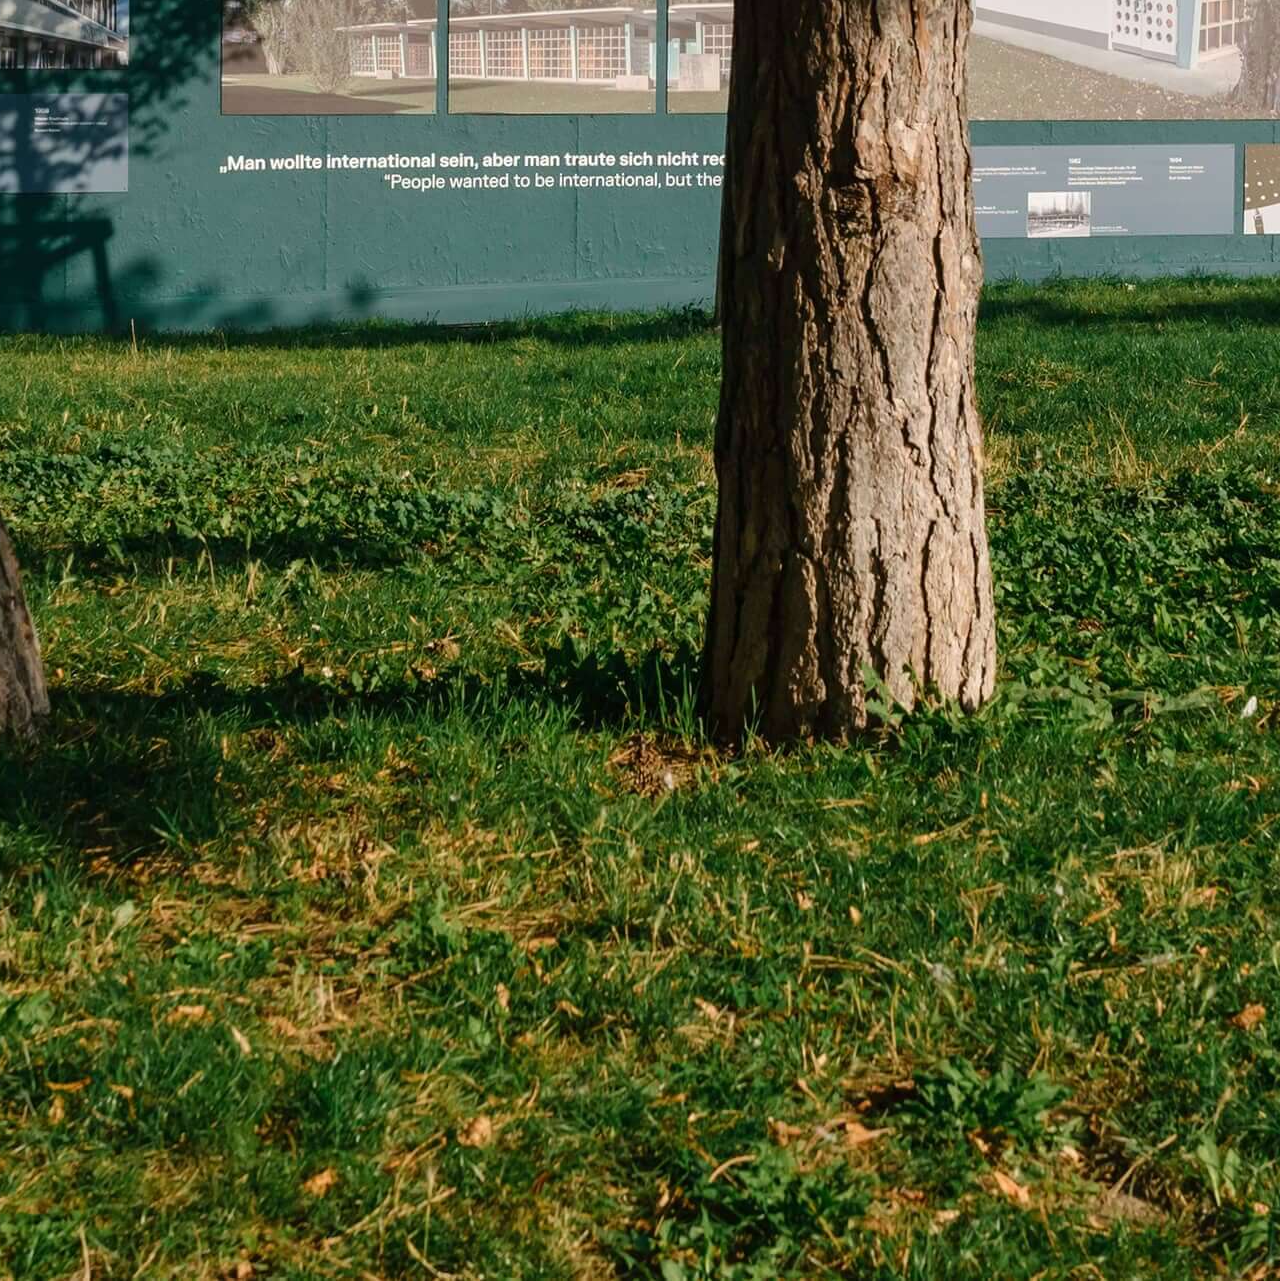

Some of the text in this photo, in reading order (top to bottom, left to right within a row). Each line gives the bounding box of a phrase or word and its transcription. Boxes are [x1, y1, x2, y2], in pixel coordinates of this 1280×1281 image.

[220, 155, 267, 173] „Man
[270, 154, 323, 170] wollte
[326, 153, 435, 169] international
[439, 153, 479, 170] sein,
[482, 152, 521, 167] aber
[524, 154, 561, 167] man
[564, 152, 616, 167] traute
[619, 151, 653, 167] sich
[657, 151, 699, 167] nicht
[384, 171, 724, 192] “People wanted to be international, but the
